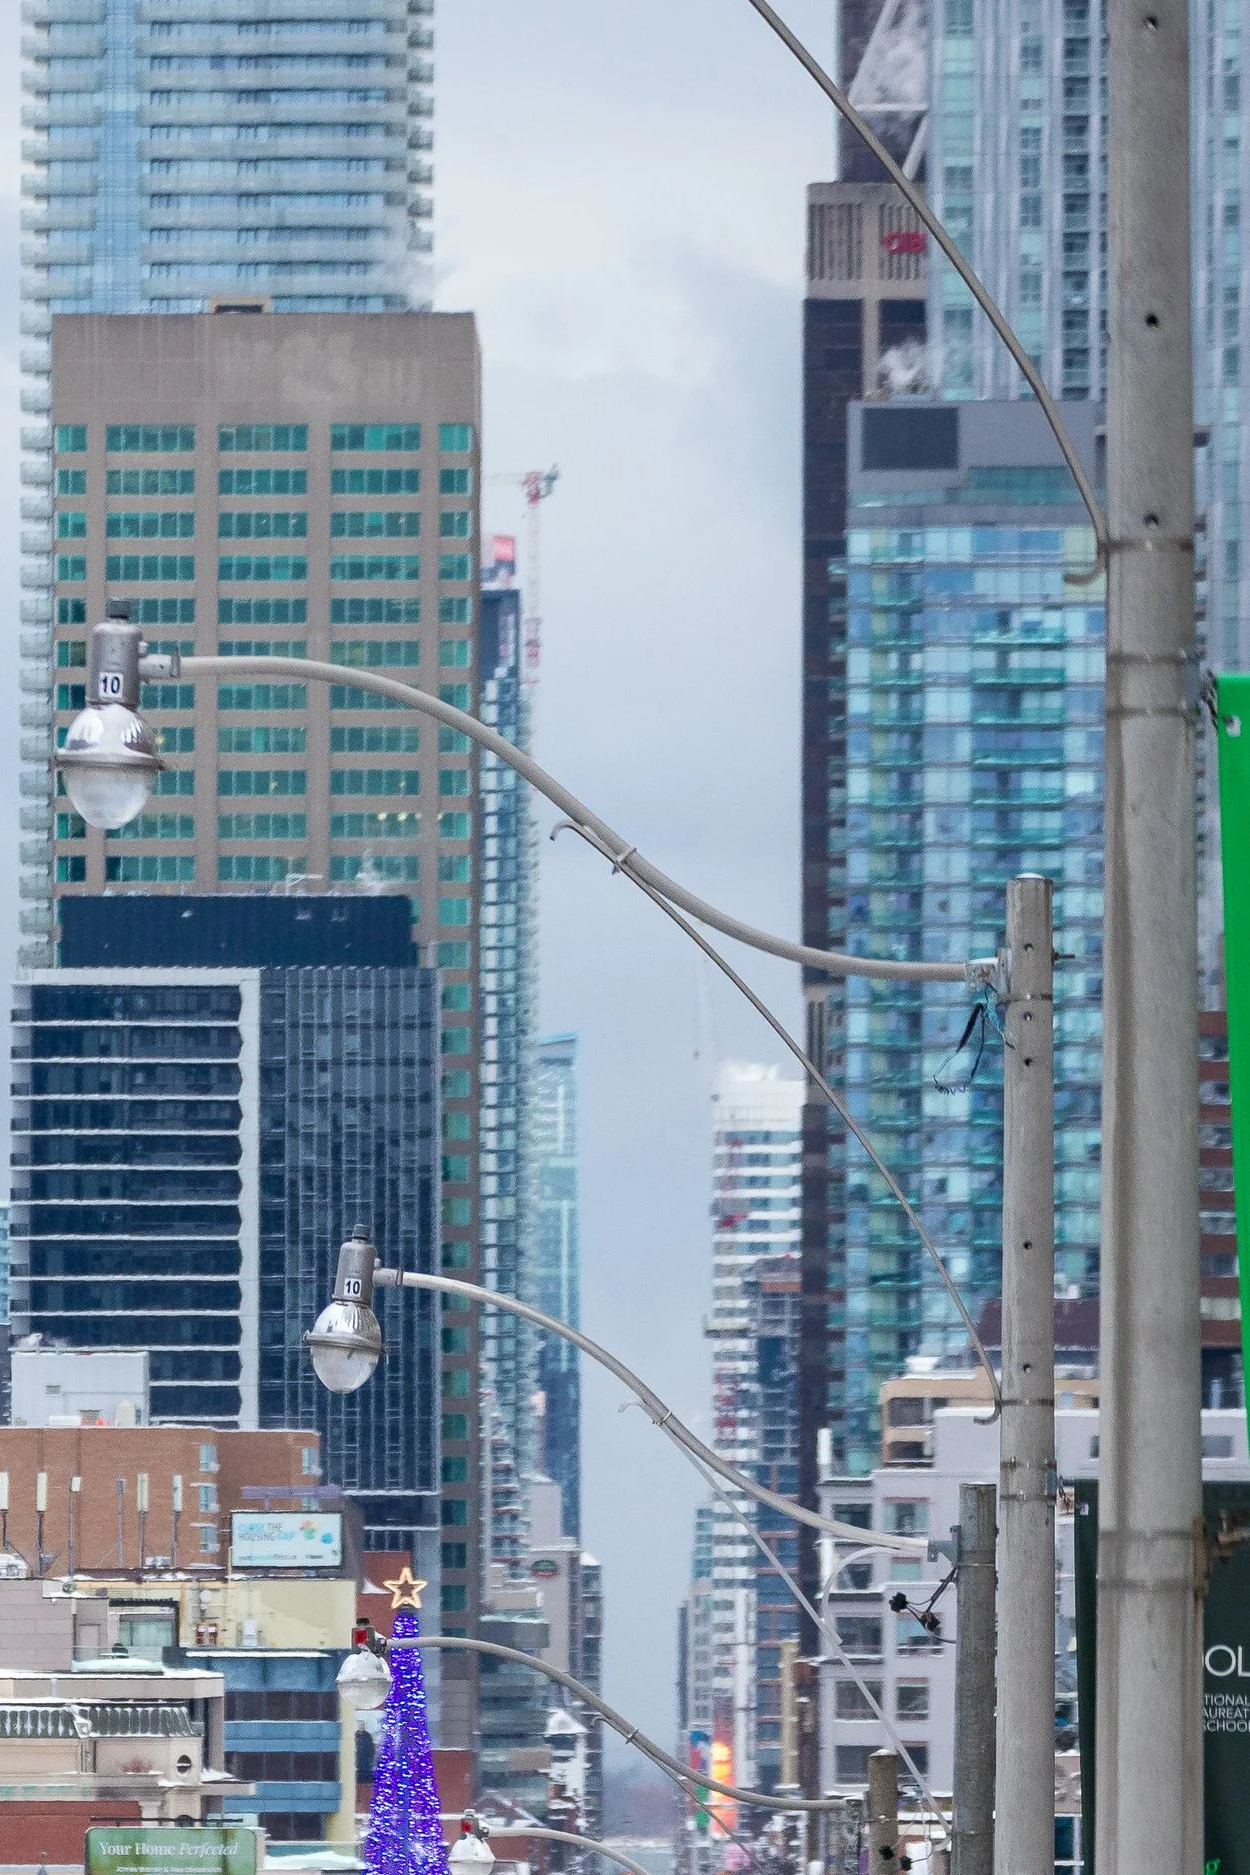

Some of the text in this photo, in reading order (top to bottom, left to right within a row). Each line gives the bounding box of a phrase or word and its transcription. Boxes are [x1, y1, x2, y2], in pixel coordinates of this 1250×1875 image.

[101, 675, 121, 694] 10
[345, 1281, 361, 1295] 10
[1203, 1645, 1250, 1676] OL
[1203, 1719, 1250, 1732] CHOO
[100, 1841, 239, 1857] Your Home Perfected
